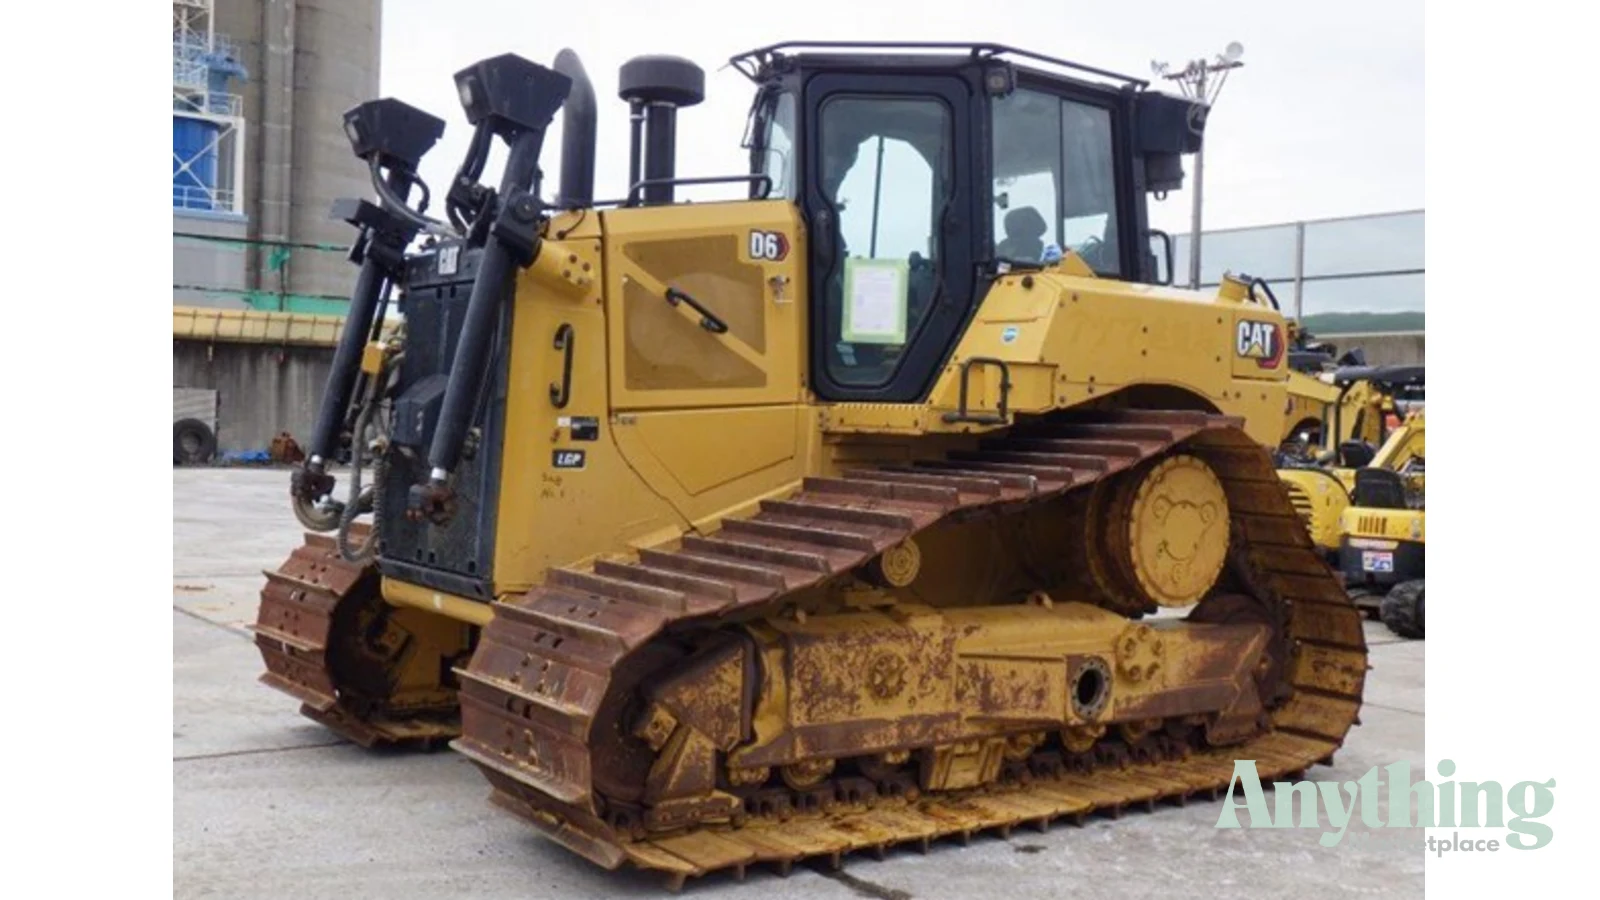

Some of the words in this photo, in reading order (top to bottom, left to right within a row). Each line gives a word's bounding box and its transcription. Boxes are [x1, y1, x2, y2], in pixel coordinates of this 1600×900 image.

[750, 231, 778, 260] D6
[1237, 320, 1275, 358] CAT
[557, 452, 582, 465] LGP
